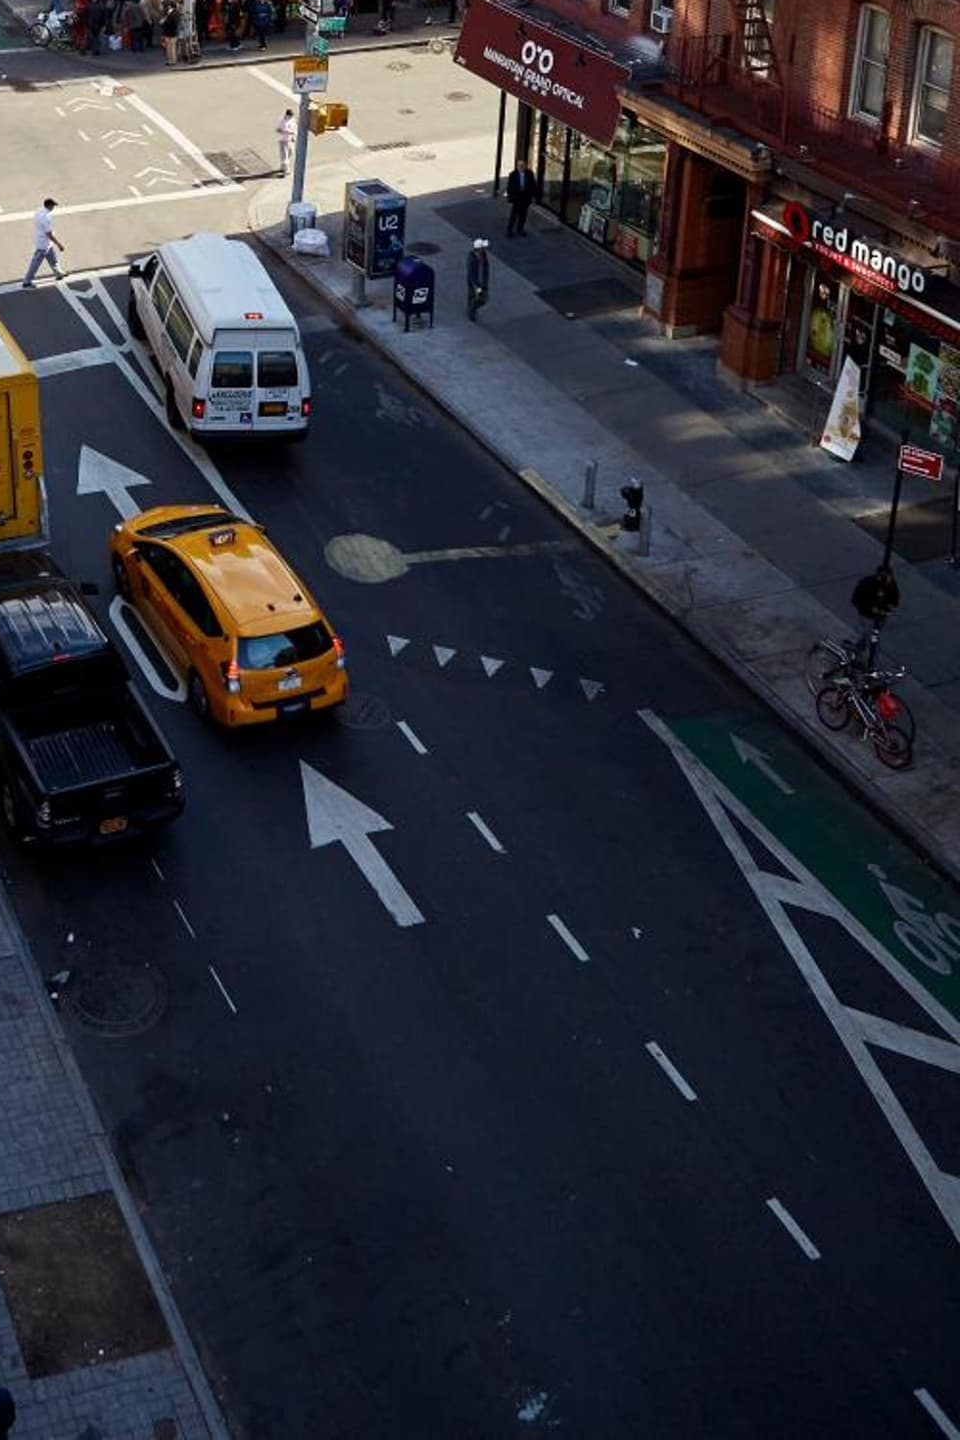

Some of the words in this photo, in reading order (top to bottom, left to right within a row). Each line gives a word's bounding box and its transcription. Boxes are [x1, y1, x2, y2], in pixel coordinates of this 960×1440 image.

[524, 68, 552, 92] GRAND
[552, 83, 584, 109] OPTICAL
[811, 220, 848, 253] red
[851, 239, 925, 293] mango
